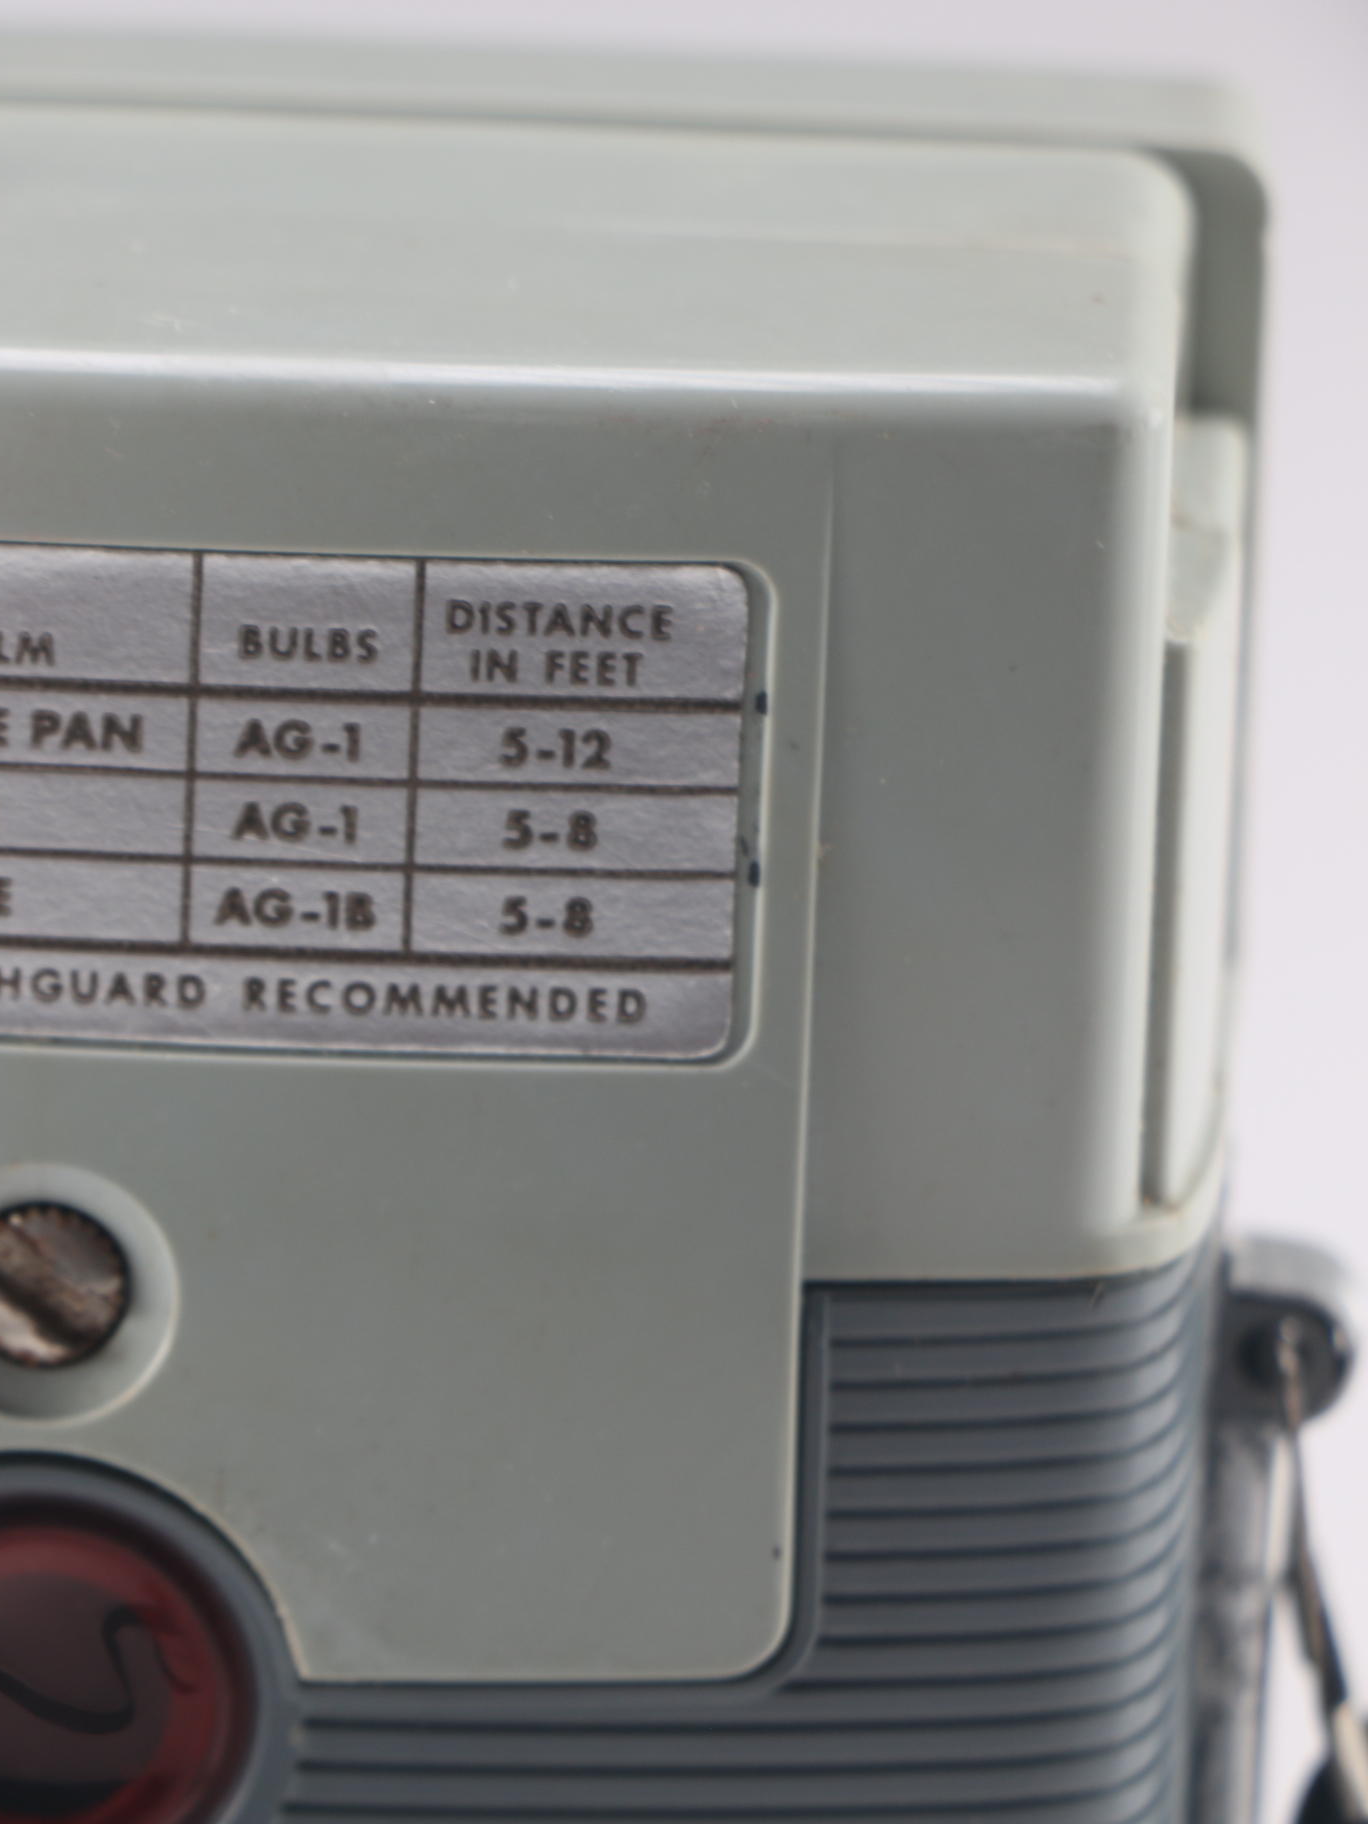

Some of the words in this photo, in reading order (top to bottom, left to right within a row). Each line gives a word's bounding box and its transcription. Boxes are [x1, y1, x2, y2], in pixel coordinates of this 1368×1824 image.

[447, 599, 674, 642] DISTANCE
[238, 625, 380, 663] BULBS
[470, 649, 519, 685] IN
[545, 650, 644, 687] FEET
[31, 709, 144, 753] PAN
[235, 719, 362, 762] AG-1
[499, 727, 612, 770] 5-12
[233, 802, 359, 844] AG-1
[502, 810, 598, 851] 5-8
[215, 888, 376, 931] AG-1B
[499, 897, 594, 937] 5-8
[243, 976, 648, 1024] RECOMMENDED
